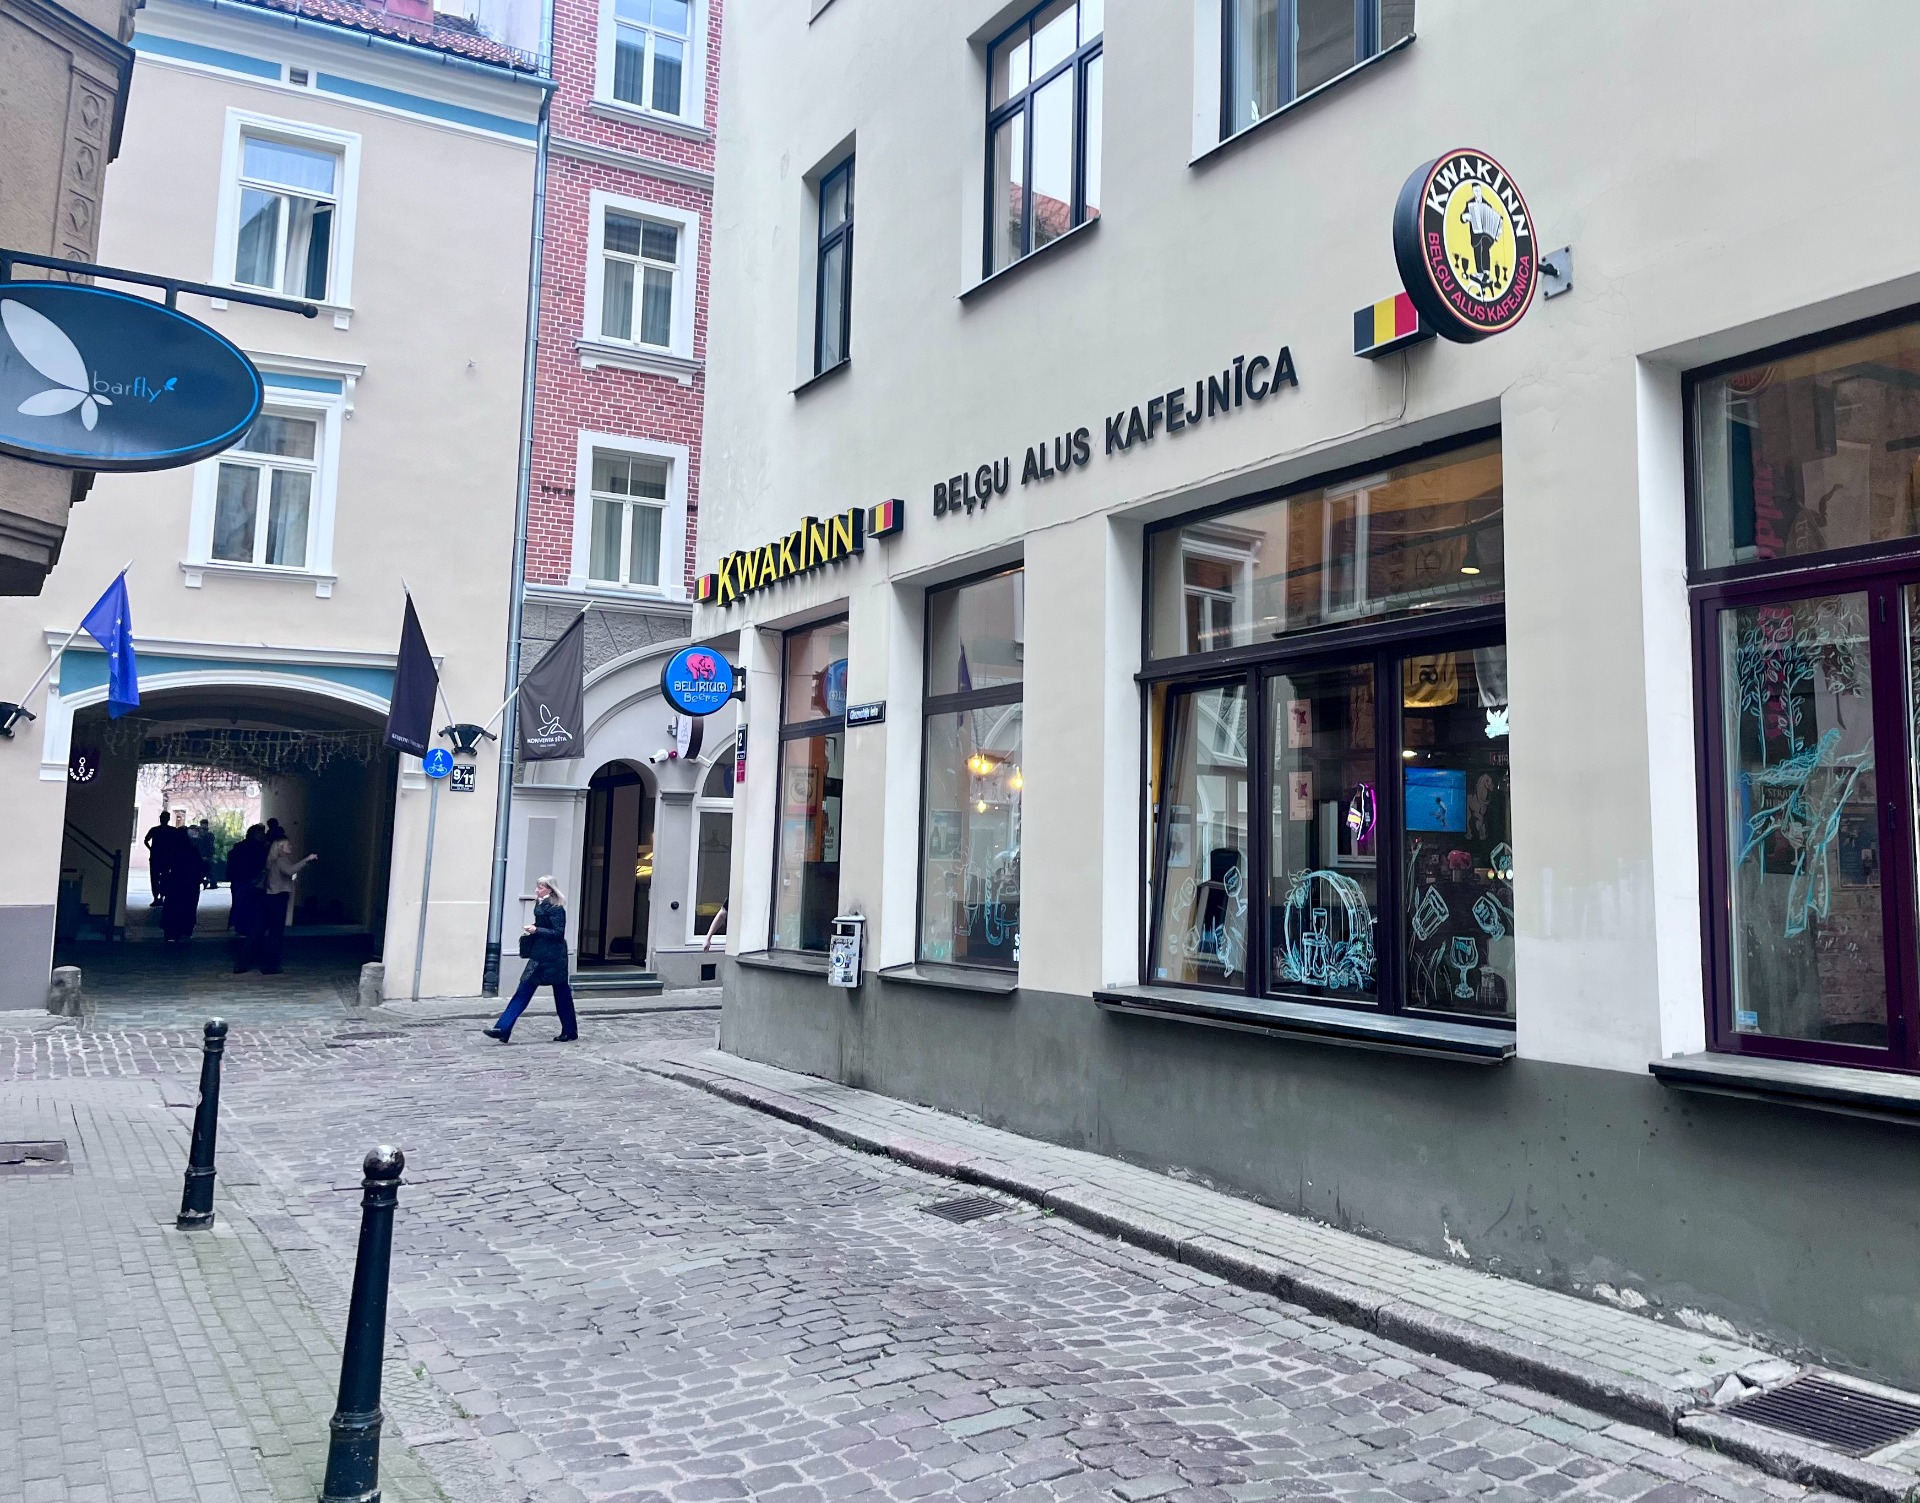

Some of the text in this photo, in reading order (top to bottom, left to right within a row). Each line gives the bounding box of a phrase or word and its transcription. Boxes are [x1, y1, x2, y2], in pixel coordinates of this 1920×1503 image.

[1451, 291, 1486, 321] ALUS
[1487, 255, 1530, 322] KAFEJNĪCA
[93, 369, 162, 403] barfly
[1021, 427, 1091, 485] ALUS
[1105, 345, 1299, 455] KAFEJNĪCA
[674, 680, 728, 693] DELIRIUM
[738, 732, 743, 747] 2
[453, 768, 474, 785] 9/11
